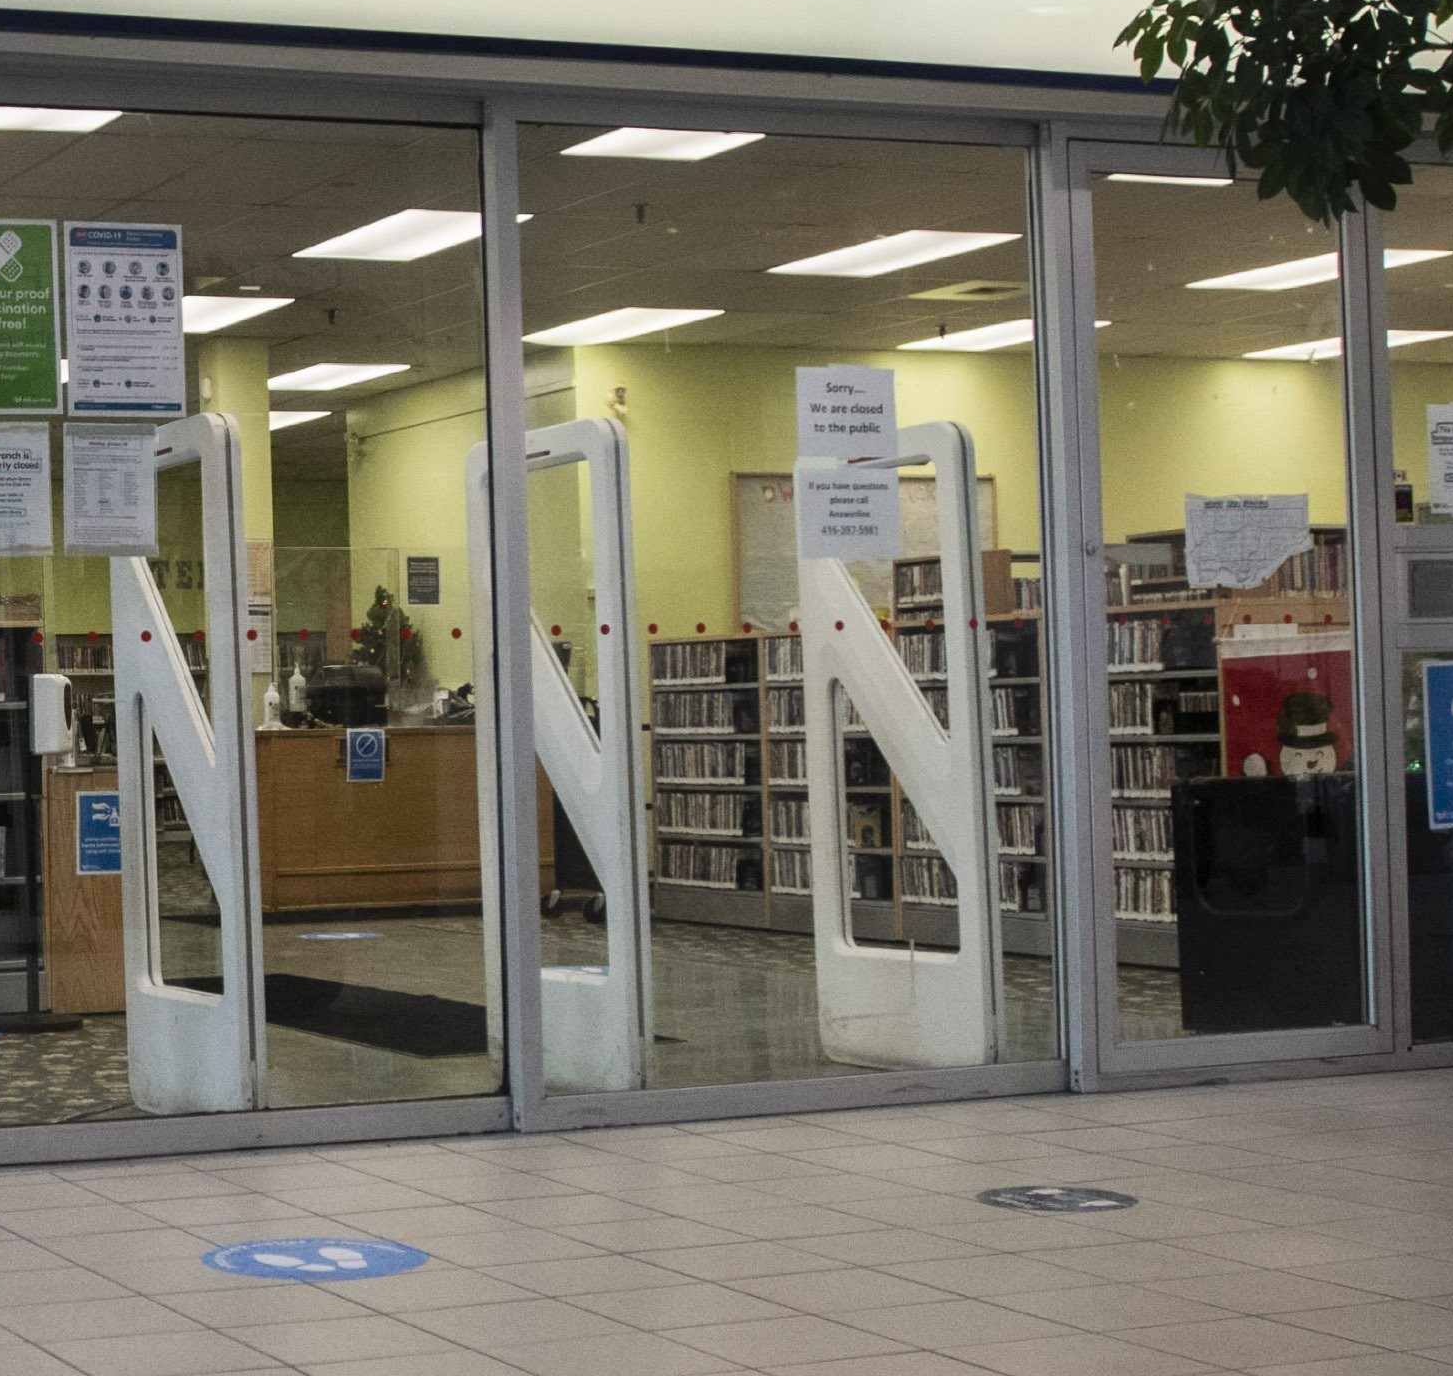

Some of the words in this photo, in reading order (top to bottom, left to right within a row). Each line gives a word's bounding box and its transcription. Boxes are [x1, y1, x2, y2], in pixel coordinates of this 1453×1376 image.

[15, 286, 50, 301] proof
[810, 403, 827, 413] We
[830, 405, 848, 414] are
[850, 403, 883, 414] closed
[814, 423, 825, 433] to
[828, 423, 847, 433] the
[849, 423, 881, 435] public
[23, 451, 30, 460] is
[13, 461, 39, 470] closed
[833, 482, 850, 490] have
[852, 483, 889, 491] questions
[830, 497, 855, 505] please
[856, 496, 869, 504] call
